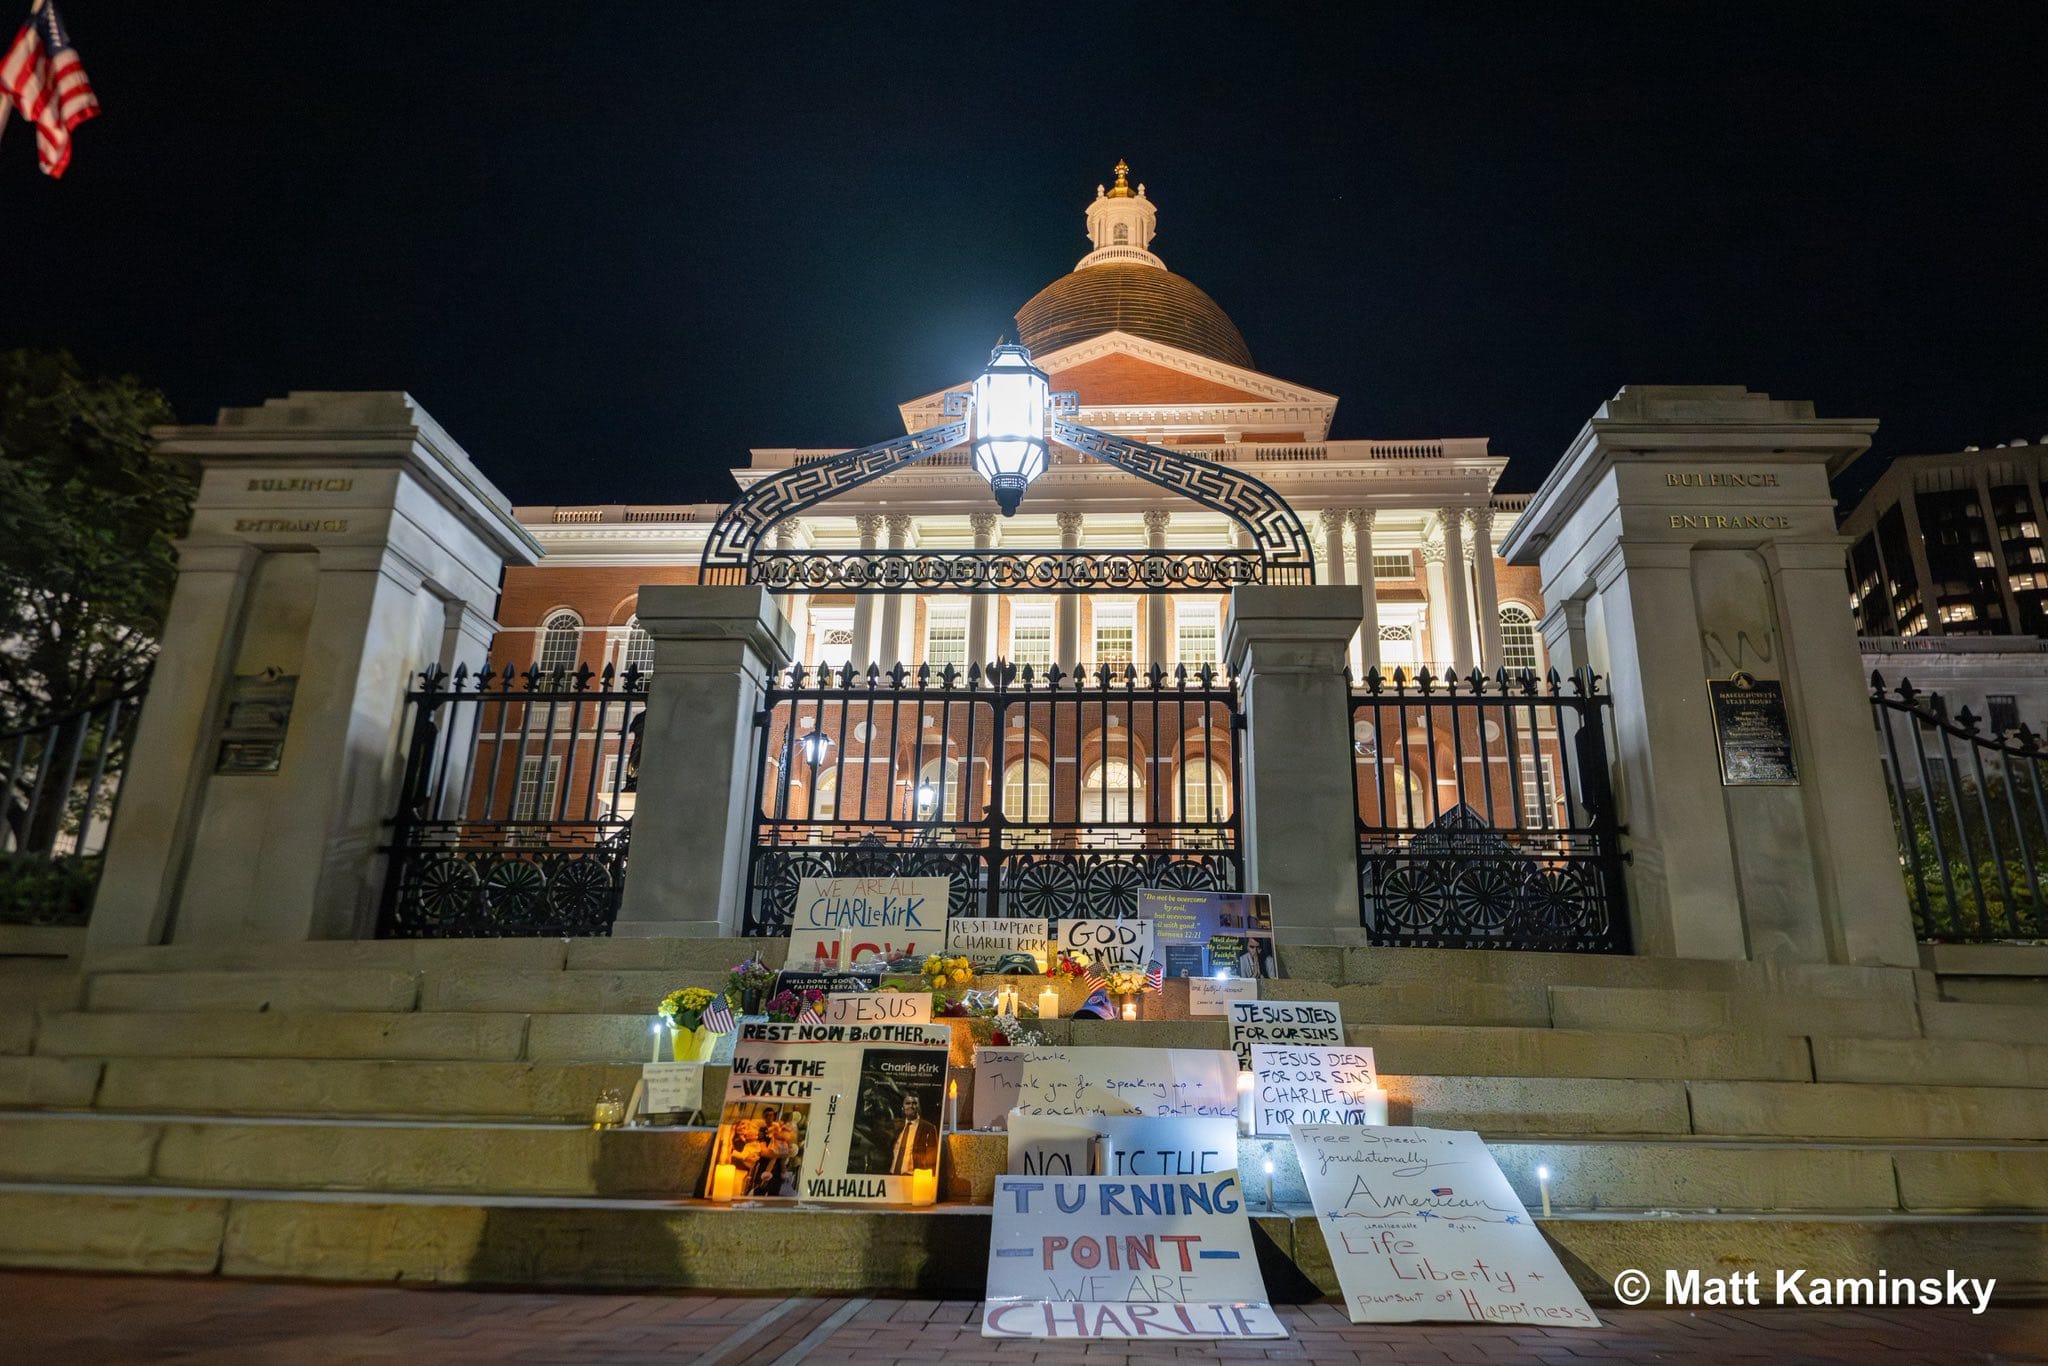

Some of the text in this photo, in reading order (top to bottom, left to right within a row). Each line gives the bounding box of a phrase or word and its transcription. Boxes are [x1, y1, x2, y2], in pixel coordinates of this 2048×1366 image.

[1666, 473, 1780, 487] BULFINCH
[1669, 515, 1792, 529] ENTRANCE
[760, 560, 1252, 582] MASSACHUSETTS STATE HOUSE
[816, 878, 922, 897] WE ARE ALL
[1164, 904, 1171, 912] by
[953, 920, 1043, 935] REST IN PEACE
[1069, 921, 1136, 947] GOD
[954, 935, 1047, 952] CHARLIE KIRK
[814, 940, 916, 972] NOW
[1066, 945, 1144, 965] FAMILY
[834, 997, 917, 1021] JESUS
[1234, 1004, 1337, 1024] JESUS DIED
[1234, 1026, 1339, 1040] FOR OUR SINS
[881, 1062, 939, 1073] Charlie Kirk
[983, 1051, 1019, 1064] Dear
[1262, 1051, 1321, 1067] JESUS
[1327, 1053, 1367, 1068] DIED
[990, 1072, 1040, 1092] Thank
[1044, 1082, 1067, 1102] you
[1075, 1074, 1093, 1099] for
[1172, 1082, 1188, 1094] up
[1259, 1070, 1371, 1084] FOR OUR SINS
[1263, 1086, 1337, 1104] CHARLIE
[1020, 1100, 1106, 1116] teaching
[1123, 1106, 1143, 1115] us
[1265, 1109, 1294, 1125] FOR
[1302, 1109, 1334, 1125] OUR
[824, 1095, 838, 1144] UNTIL
[1300, 1128, 1427, 1149] Free Speech
[1157, 1150, 1218, 1175] THE
[1318, 1149, 1452, 1177] foundationally
[807, 1178, 887, 1198] VALHALLA
[1003, 1178, 1239, 1215] TURNING
[1344, 1175, 1497, 1211] American
[1042, 1235, 1202, 1271] POINT
[1340, 1231, 1419, 1255] Life
[1389, 1257, 1517, 1293] Liberty
[1048, 1275, 1200, 1303] WE ARE
[1357, 1288, 1592, 1322] pursuit of Happiness
[987, 1303, 1279, 1337] CHARLIE
